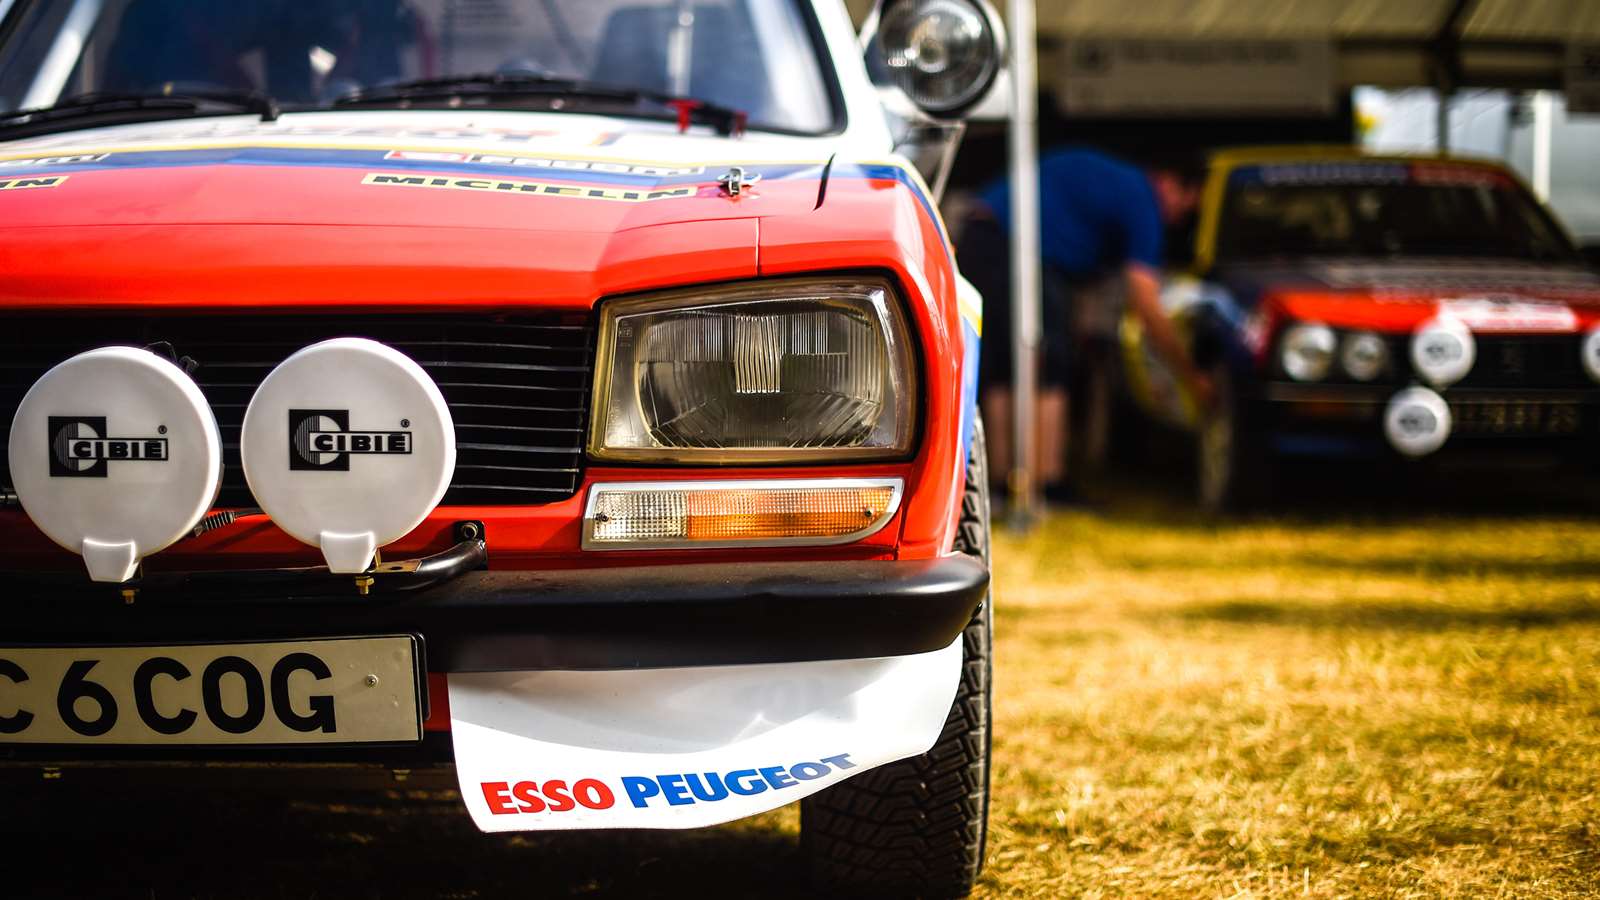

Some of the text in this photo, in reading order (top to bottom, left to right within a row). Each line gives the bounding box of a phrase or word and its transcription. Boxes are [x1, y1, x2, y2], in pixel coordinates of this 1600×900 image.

[372, 175, 689, 200] MICHELIN
[132, 652, 337, 735] COG
[480, 752, 857, 815] ESSO PEUGEOT
